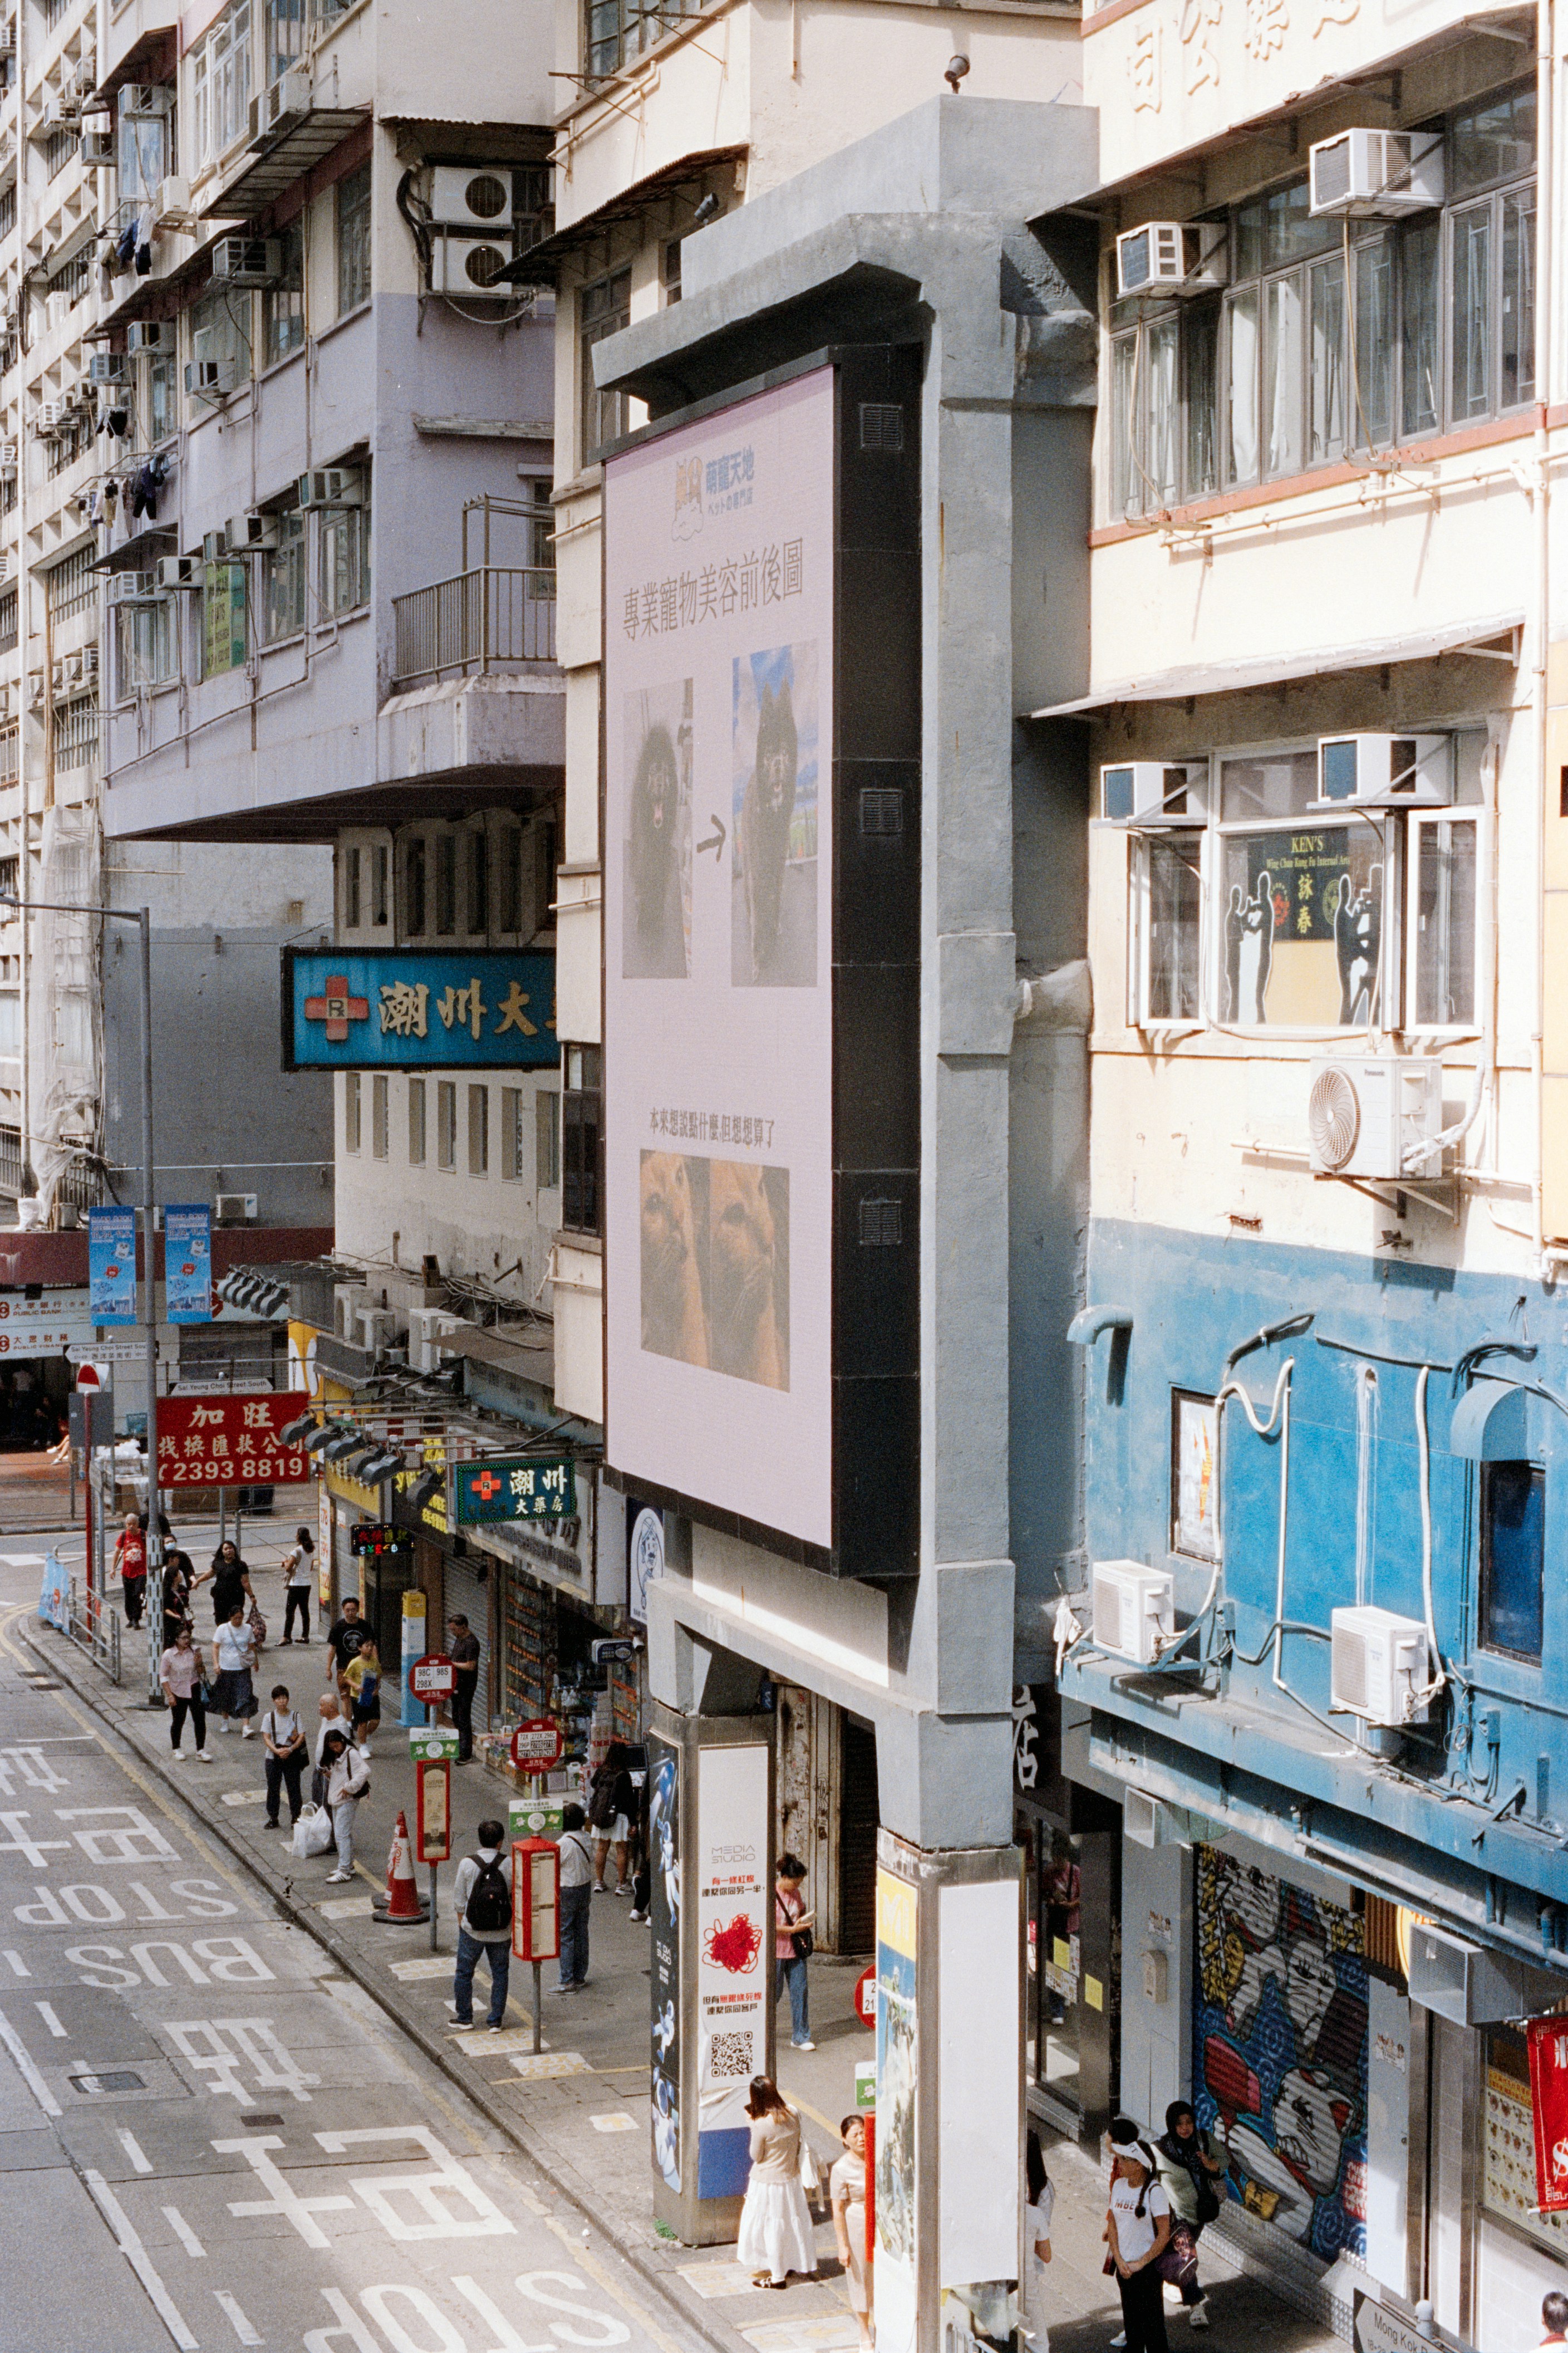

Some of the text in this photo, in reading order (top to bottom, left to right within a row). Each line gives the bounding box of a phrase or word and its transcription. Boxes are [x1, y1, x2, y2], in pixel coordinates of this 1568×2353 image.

[623, 538, 803, 641] 專業寵物美容前後圖
[1291, 836, 1324, 852] KEN'S
[379, 978, 557, 1040] 潮州大
[188, 1401, 274, 1428] 加旺
[173, 1457, 303, 1481] 2393 8819
[510, 1465, 567, 1496] 潮州
[515, 1496, 563, 1514] 大藥房
[416, 1679, 432, 1688] 298X
[418, 1667, 449, 1677] 98C 98S
[711, 1845, 755, 1855] MEDIA
[711, 1853, 756, 1864] STUDIO
[13, 1879, 238, 1925] STOP
[64, 1937, 277, 1988] BUS
[303, 2271, 631, 2353] STOP
[1374, 2312, 1418, 2353] Mong Kok
